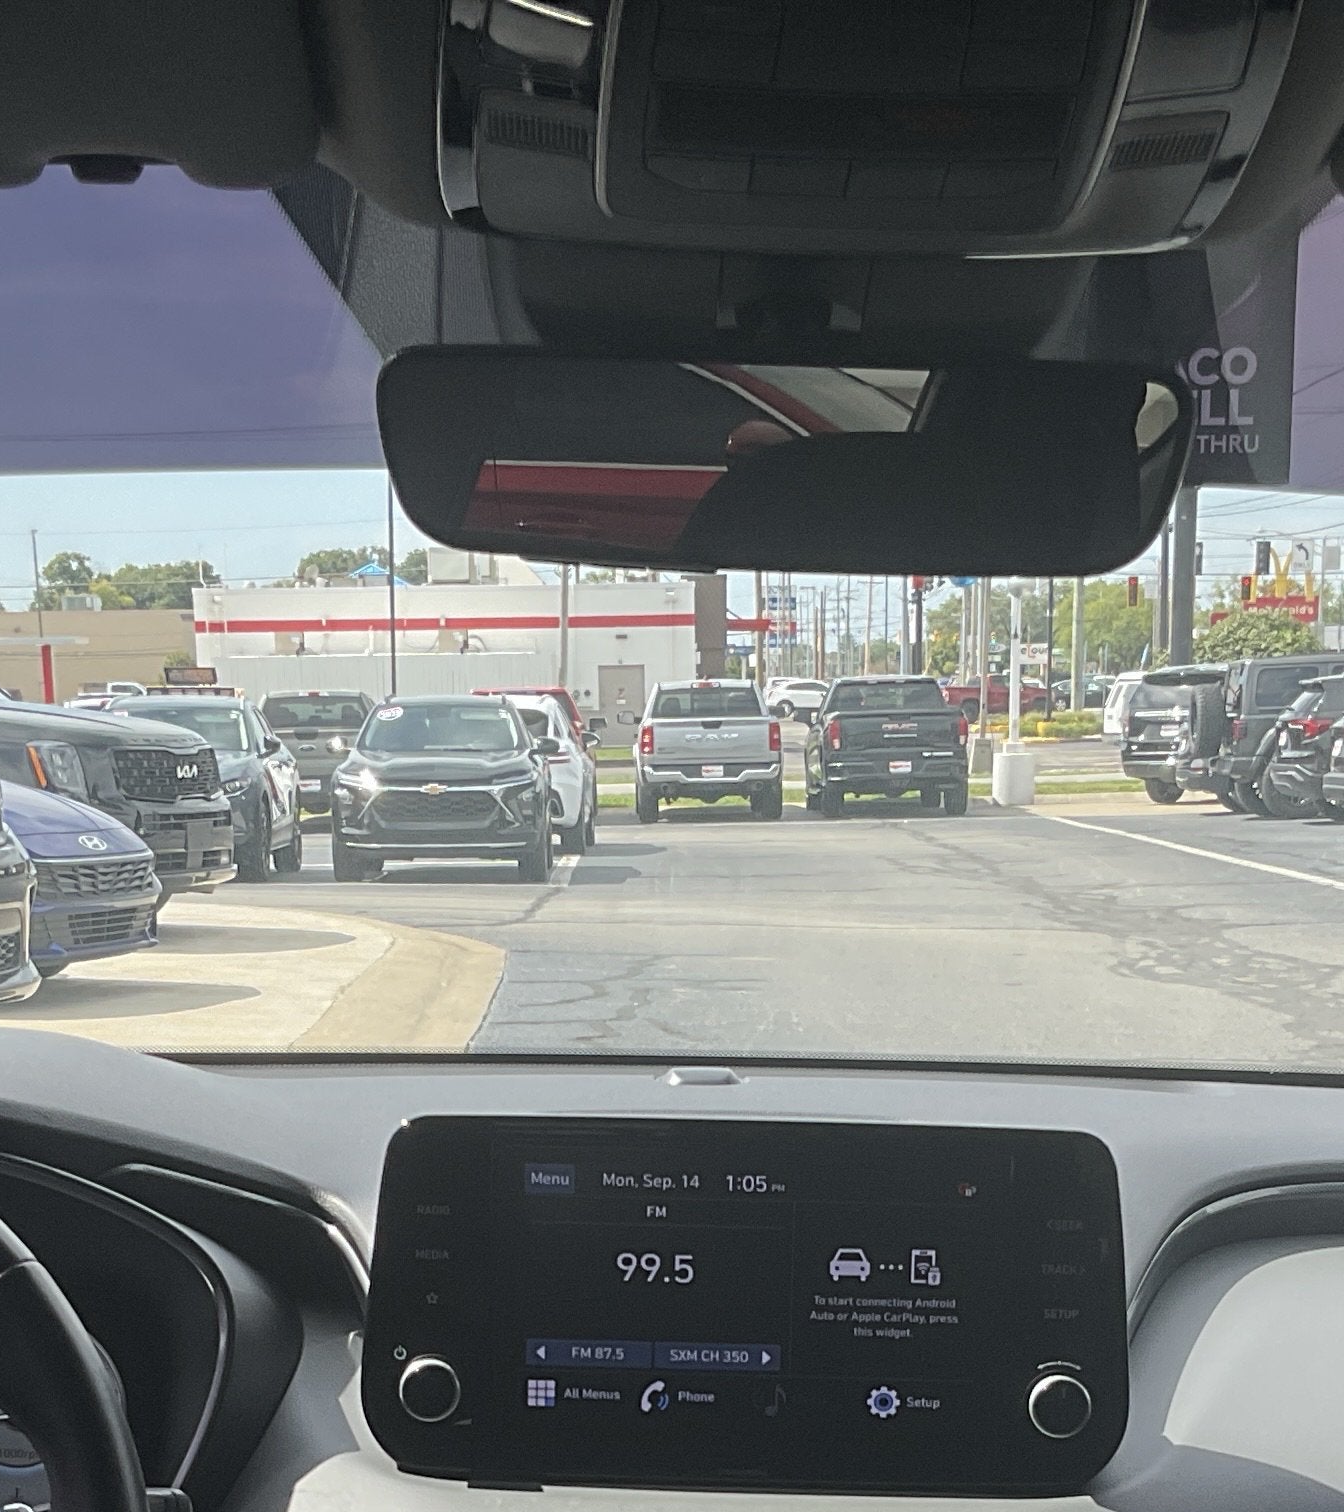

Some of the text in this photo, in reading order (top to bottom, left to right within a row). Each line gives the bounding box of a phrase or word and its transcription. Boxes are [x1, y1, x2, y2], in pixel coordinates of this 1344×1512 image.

[1179, 346, 1258, 385] CO
[1193, 389, 1254, 426] LL
[1196, 434, 1259, 454] THRU
[530, 1172, 570, 1186] Menu
[642, 1173, 676, 1191] Sep.
[681, 1174, 700, 1189] 14
[726, 1175, 785, 1193] 1:05 PM
[646, 1206, 667, 1218] FM
[616, 1252, 695, 1284] 99.5
[814, 1295, 956, 1309] To start connecting Android
[809, 1311, 834, 1321] Auto
[837, 1312, 849, 1321] or
[851, 1311, 882, 1323] Apple
[929, 1314, 958, 1324] press
[854, 1327, 873, 1337] this
[571, 1347, 625, 1360] FM 87.5
[670, 1349, 749, 1363] SXM CH 350
[563, 1387, 620, 1400] All Menus
[678, 1391, 715, 1403] Phone
[906, 1397, 941, 1409] Setup
